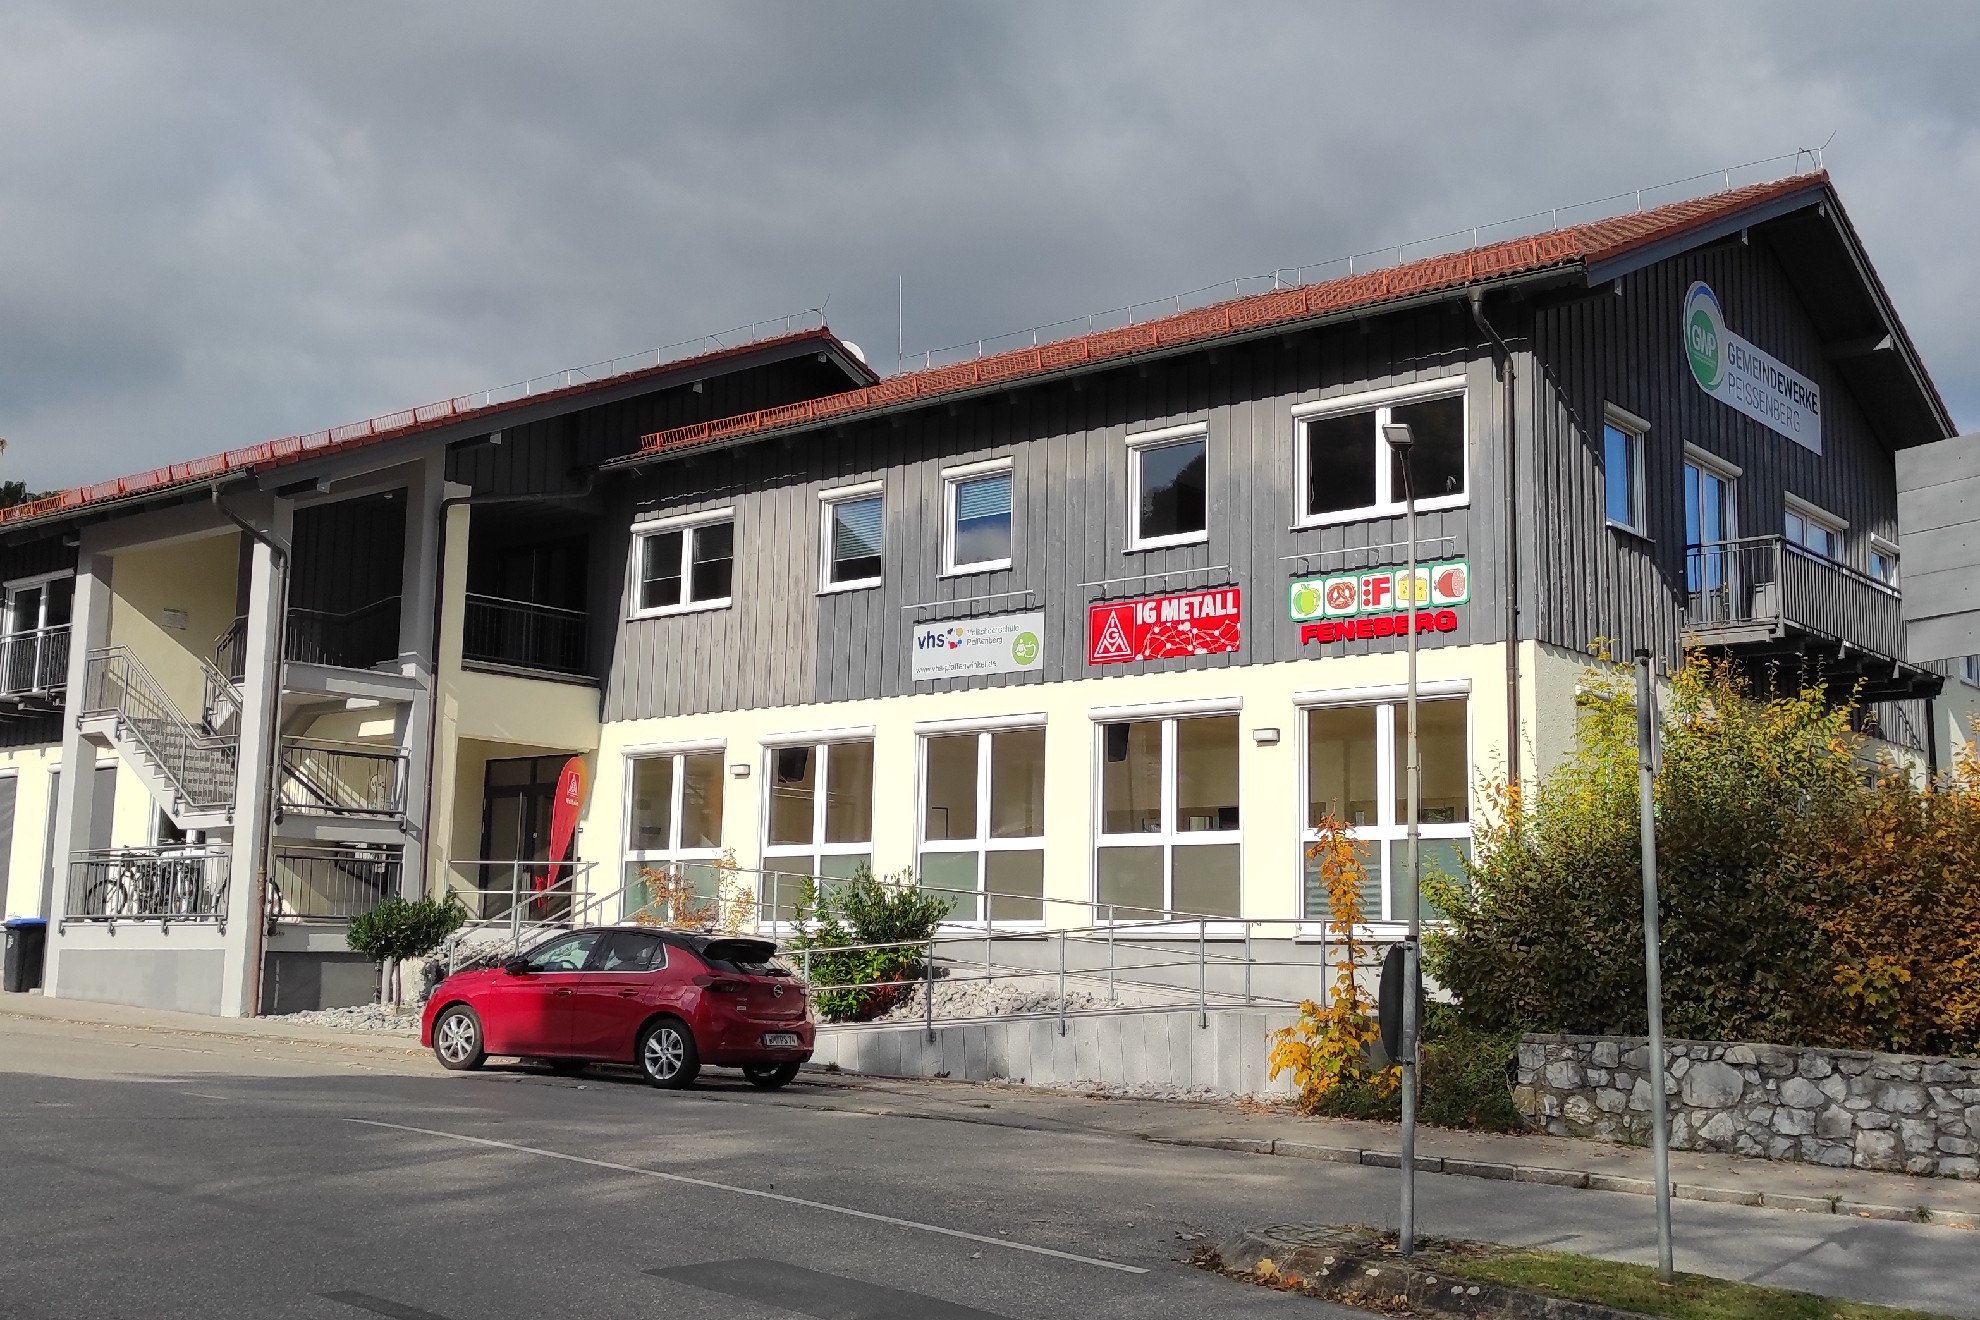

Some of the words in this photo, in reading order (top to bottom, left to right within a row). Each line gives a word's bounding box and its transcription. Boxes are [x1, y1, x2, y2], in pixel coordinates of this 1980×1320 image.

[1692, 325, 1717, 357] GWP
[1727, 341, 1819, 416] GEMEINDEWERKE
[1727, 372, 1801, 433] PEISSENBERG
[1136, 601, 1157, 625] IG
[1161, 592, 1238, 622] METALL
[917, 630, 945, 649] vhs
[967, 624, 1020, 636] Vlsocschule
[1300, 610, 1458, 645] FENEBERG
[915, 660, 997, 674] wwwvhs-paffenwinkelde
